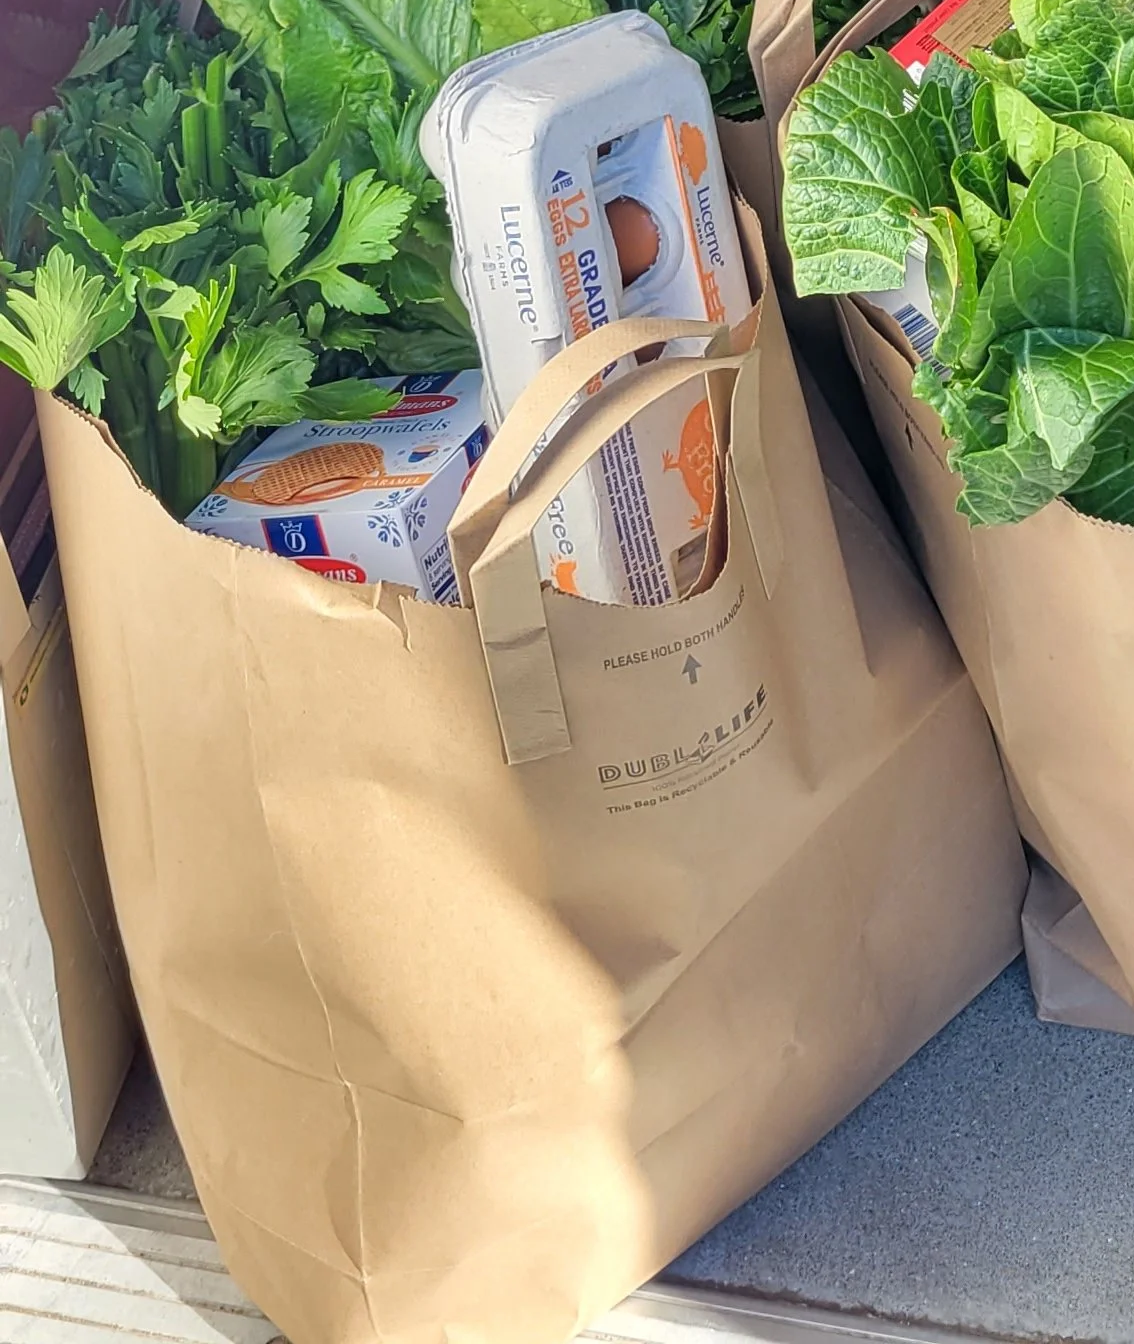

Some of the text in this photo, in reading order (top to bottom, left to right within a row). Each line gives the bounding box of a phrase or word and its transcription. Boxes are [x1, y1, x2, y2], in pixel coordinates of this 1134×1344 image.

[562, 188, 590, 237] 12
[696, 185, 723, 266] Lucerne
[495, 245, 509, 288] FARMS
[500, 204, 538, 326] Lucerne
[547, 197, 567, 247] EGGS
[559, 250, 581, 303] EXTRA
[578, 249, 610, 331] GRADE
[303, 419, 451, 440] Stroopwafels
[361, 475, 421, 489] CARAMEL
[603, 650, 649, 671] PLEASE
[650, 640, 682, 660] HOLD
[684, 626, 715, 648] BOTH
[714, 682, 767, 744] LIFE
[606, 801, 632, 815] This
[634, 797, 657, 810] Bag
[671, 764, 728, 800] Recyclable
